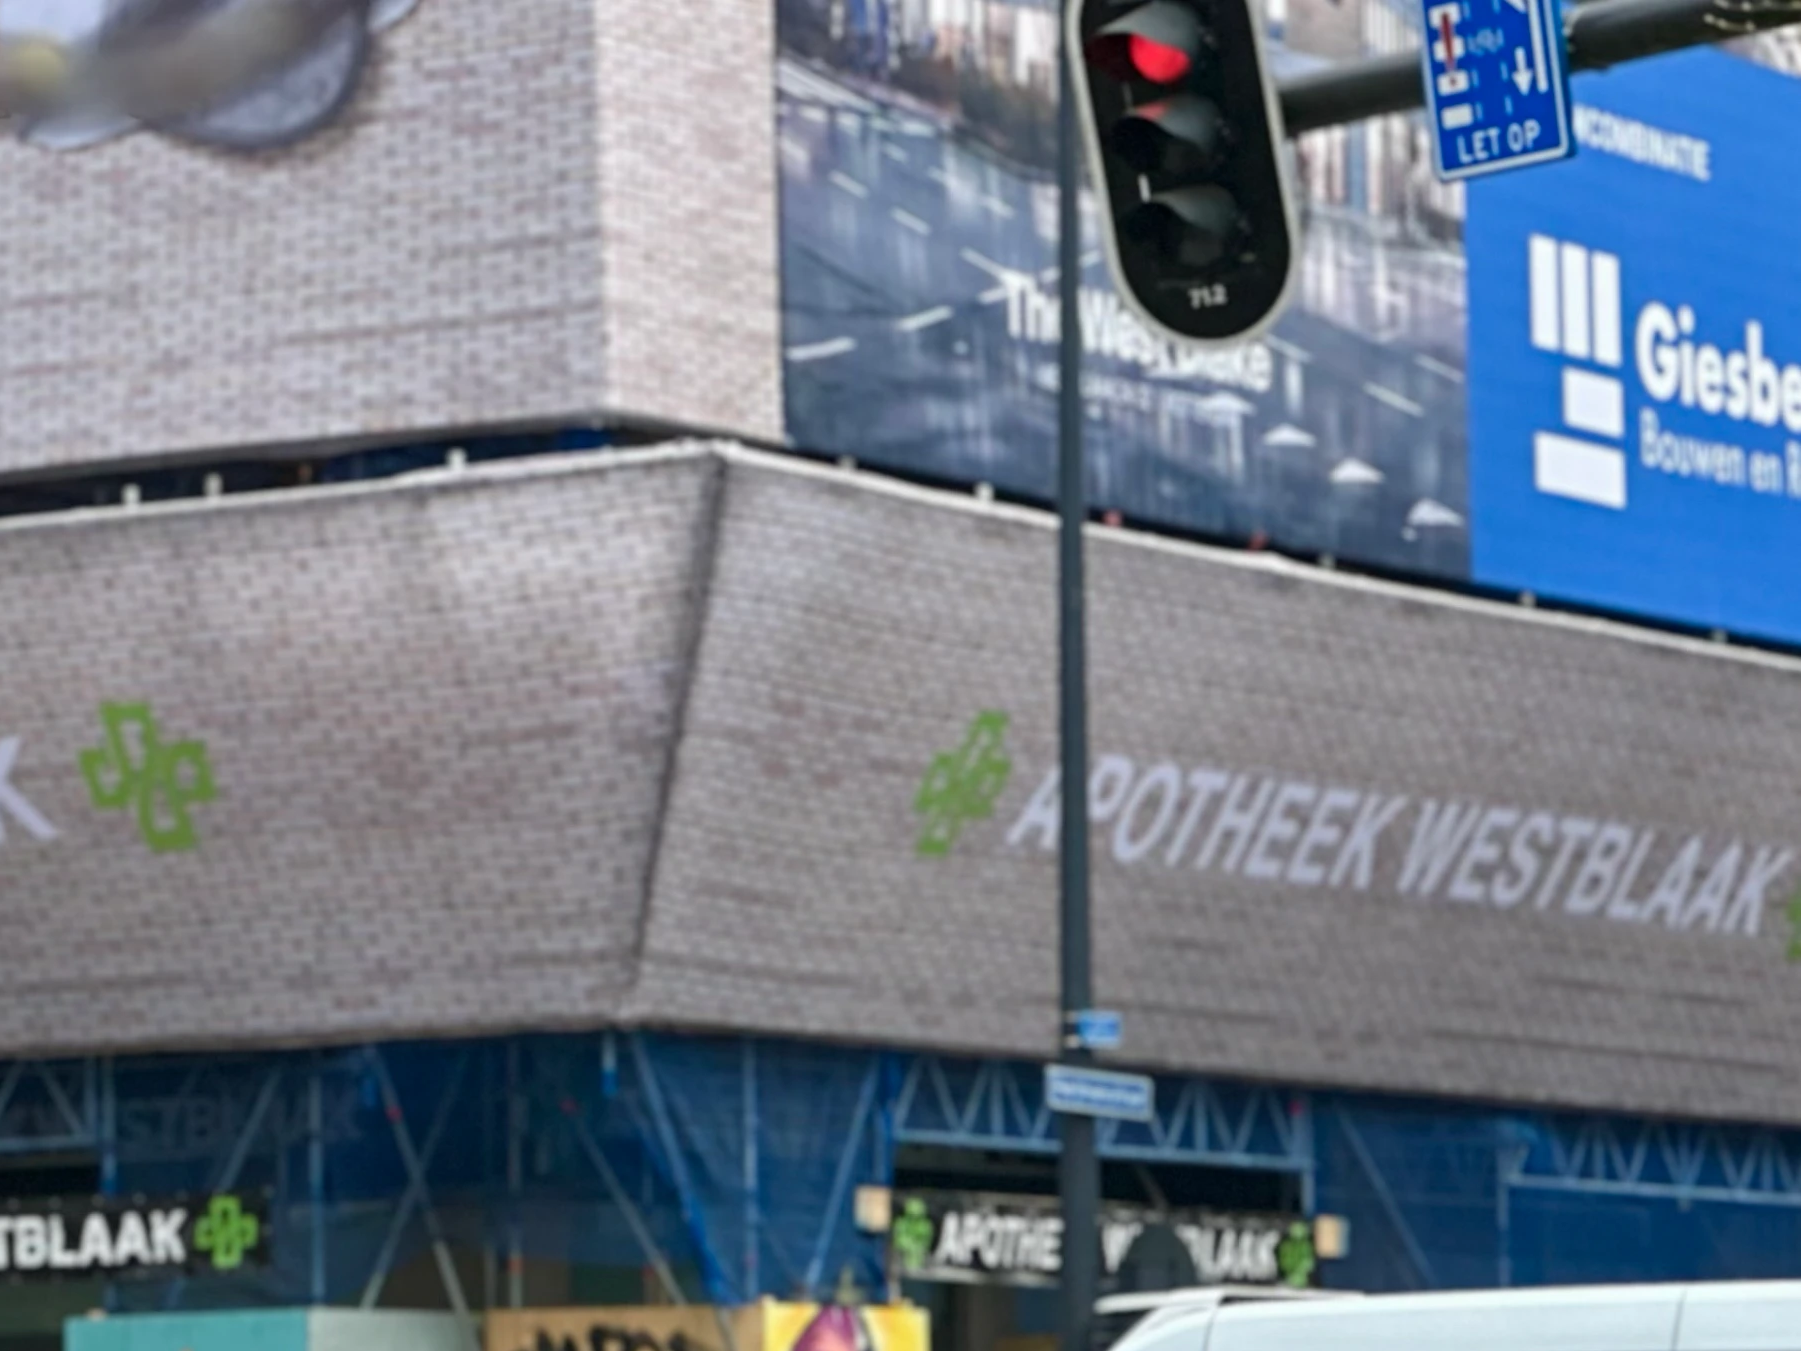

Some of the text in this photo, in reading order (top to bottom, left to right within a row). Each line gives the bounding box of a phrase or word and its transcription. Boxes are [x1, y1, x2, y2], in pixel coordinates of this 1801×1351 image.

[1456, 118, 1542, 165] LET OP
[1639, 406, 1746, 488] Bouwen
[1749, 450, 1784, 496] en
[1007, 754, 1794, 939] APOTHEEK WESTBLAAK
[934, 1211, 1064, 1272] APOTHE
